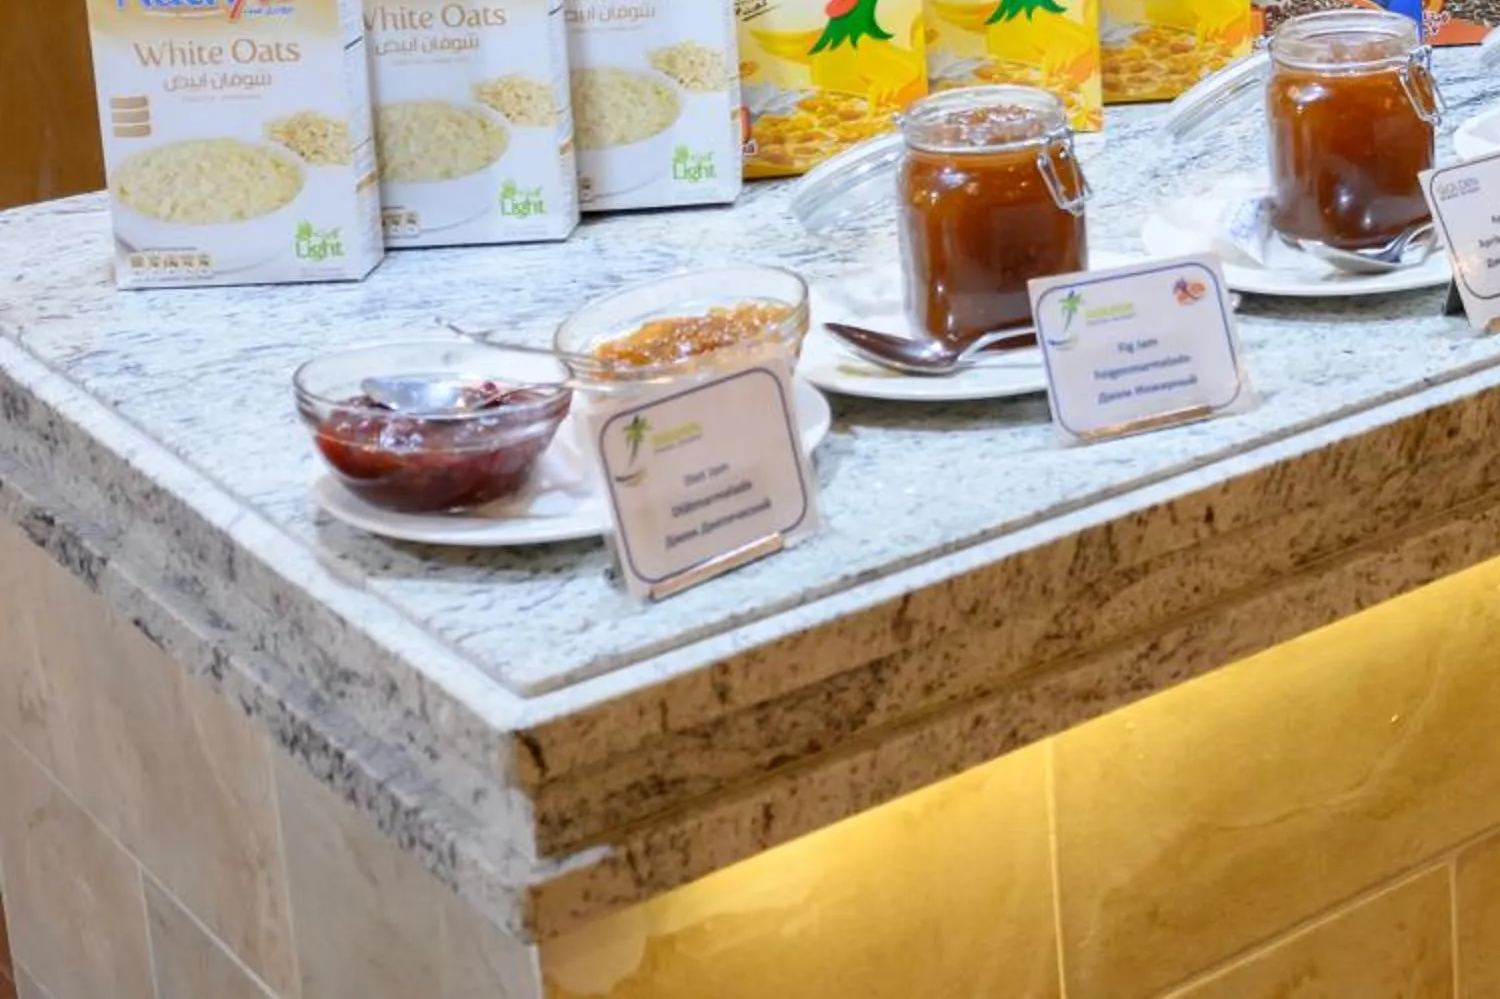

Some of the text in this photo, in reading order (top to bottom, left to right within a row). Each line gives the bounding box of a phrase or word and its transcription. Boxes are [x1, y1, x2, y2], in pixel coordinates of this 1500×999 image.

[441, 4, 506, 28] Oats
[133, 39, 301, 68] White Oats
